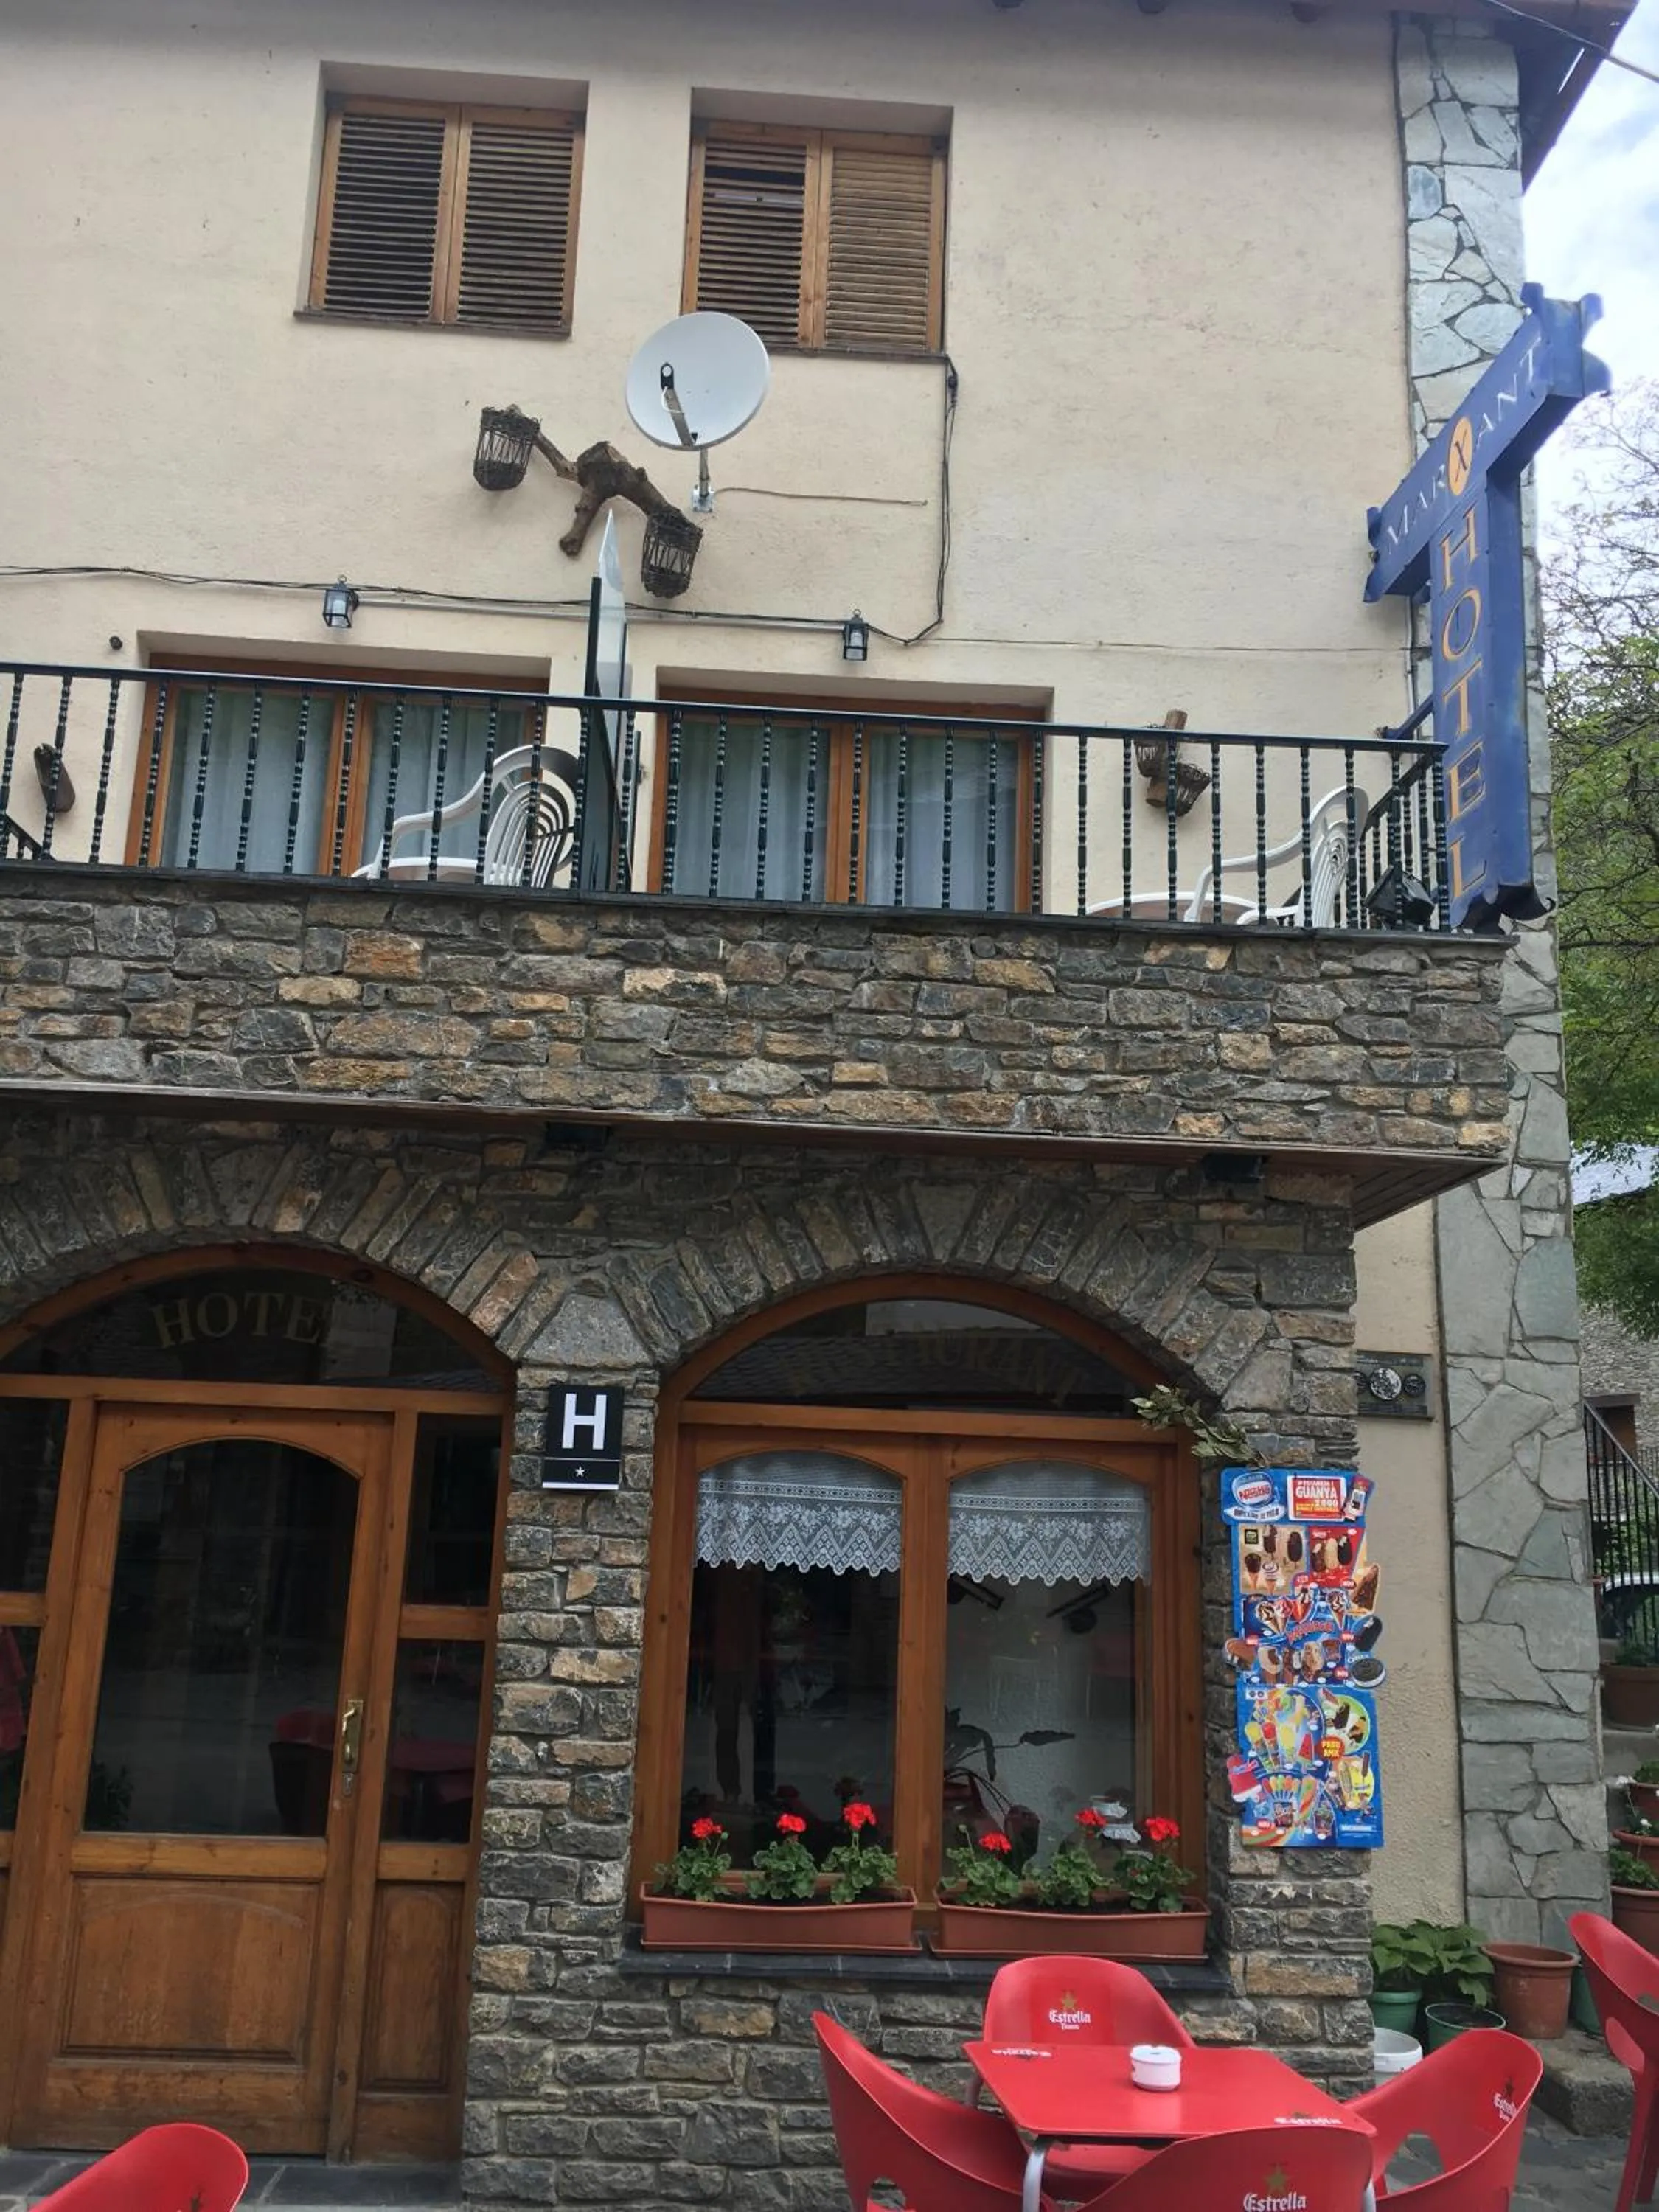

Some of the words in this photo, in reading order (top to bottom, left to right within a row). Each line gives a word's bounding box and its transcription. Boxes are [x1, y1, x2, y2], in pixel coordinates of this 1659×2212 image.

[1440, 503, 1487, 899] HOTEL
[149, 1290, 330, 1349] HOTE
[562, 1393, 607, 1450] H
[1295, 1486, 1338, 1499] GUANYA
[1049, 2008, 1091, 2024] Estrella
[1493, 2091, 1518, 2118] Estrell
[1242, 2191, 1307, 2212] Estrella
